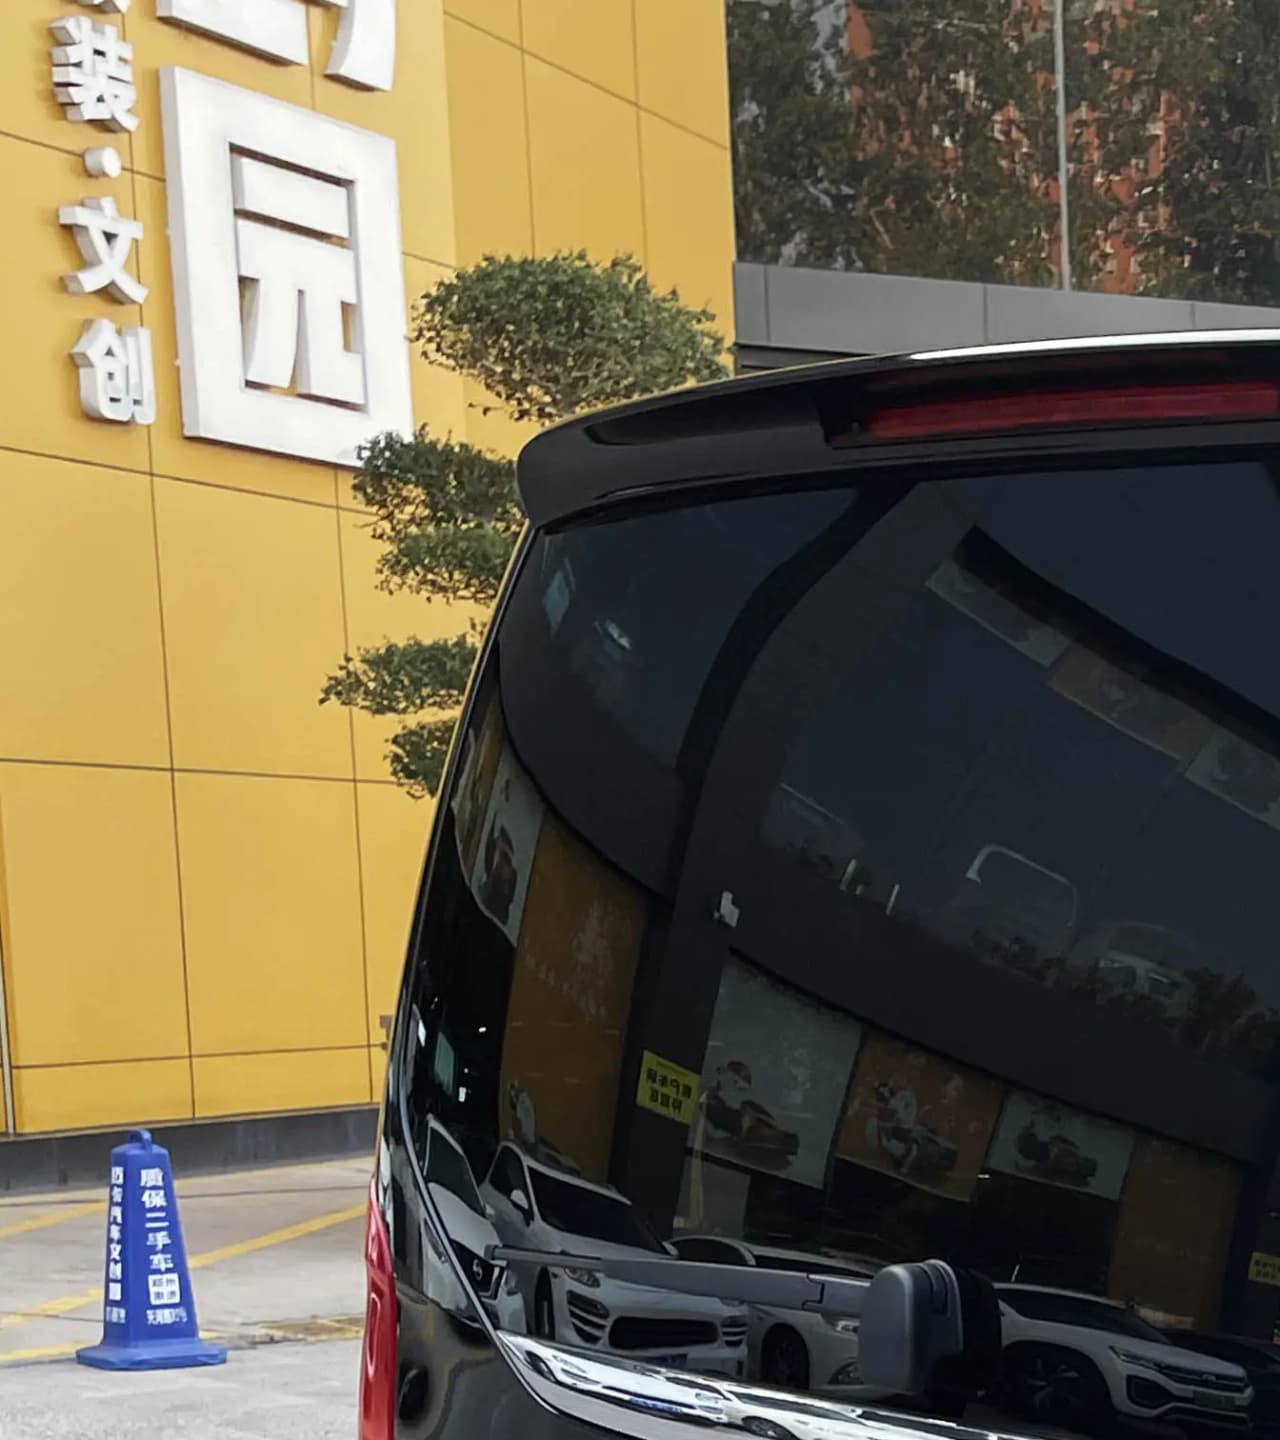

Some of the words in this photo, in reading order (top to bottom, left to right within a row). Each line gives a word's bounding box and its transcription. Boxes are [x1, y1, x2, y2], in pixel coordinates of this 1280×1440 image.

[48, 0, 156, 425] 装·文创
[140, 1167, 174, 1273] 质保二手车
